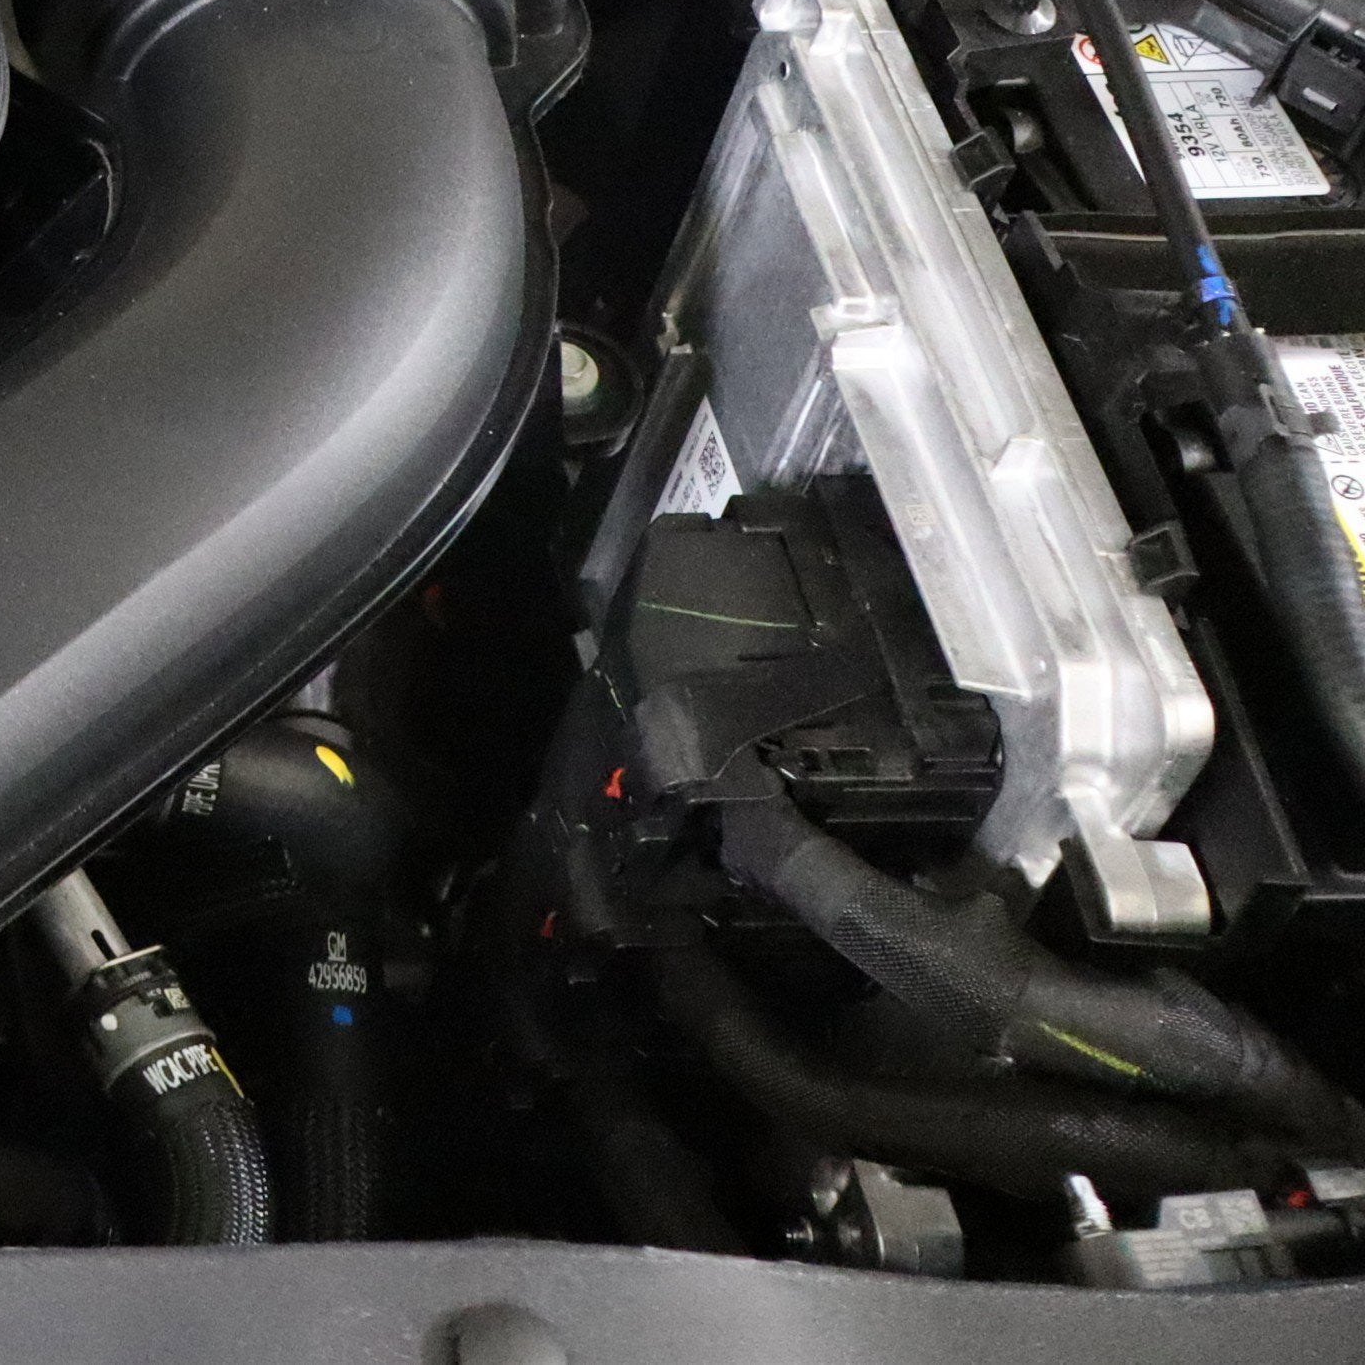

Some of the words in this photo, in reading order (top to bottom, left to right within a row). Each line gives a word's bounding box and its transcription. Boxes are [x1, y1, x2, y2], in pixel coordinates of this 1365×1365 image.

[1212, 88, 1229, 108] 730
[1168, 113, 1205, 156] 9354
[1185, 105, 1212, 138] VRLA
[1230, 118, 1252, 147] 80Ah
[1207, 143, 1226, 162] 12V
[1253, 157, 1270, 177] 730
[1298, 382, 1312, 399] CAN
[1309, 377, 1333, 411] NDNESS
[1323, 376, 1344, 404] BURNS
[1341, 408, 1365, 441] SEVERE
[327, 931, 347, 959] GM
[308, 962, 367, 993] 42956859
[142, 1051, 196, 1095] WCAC
